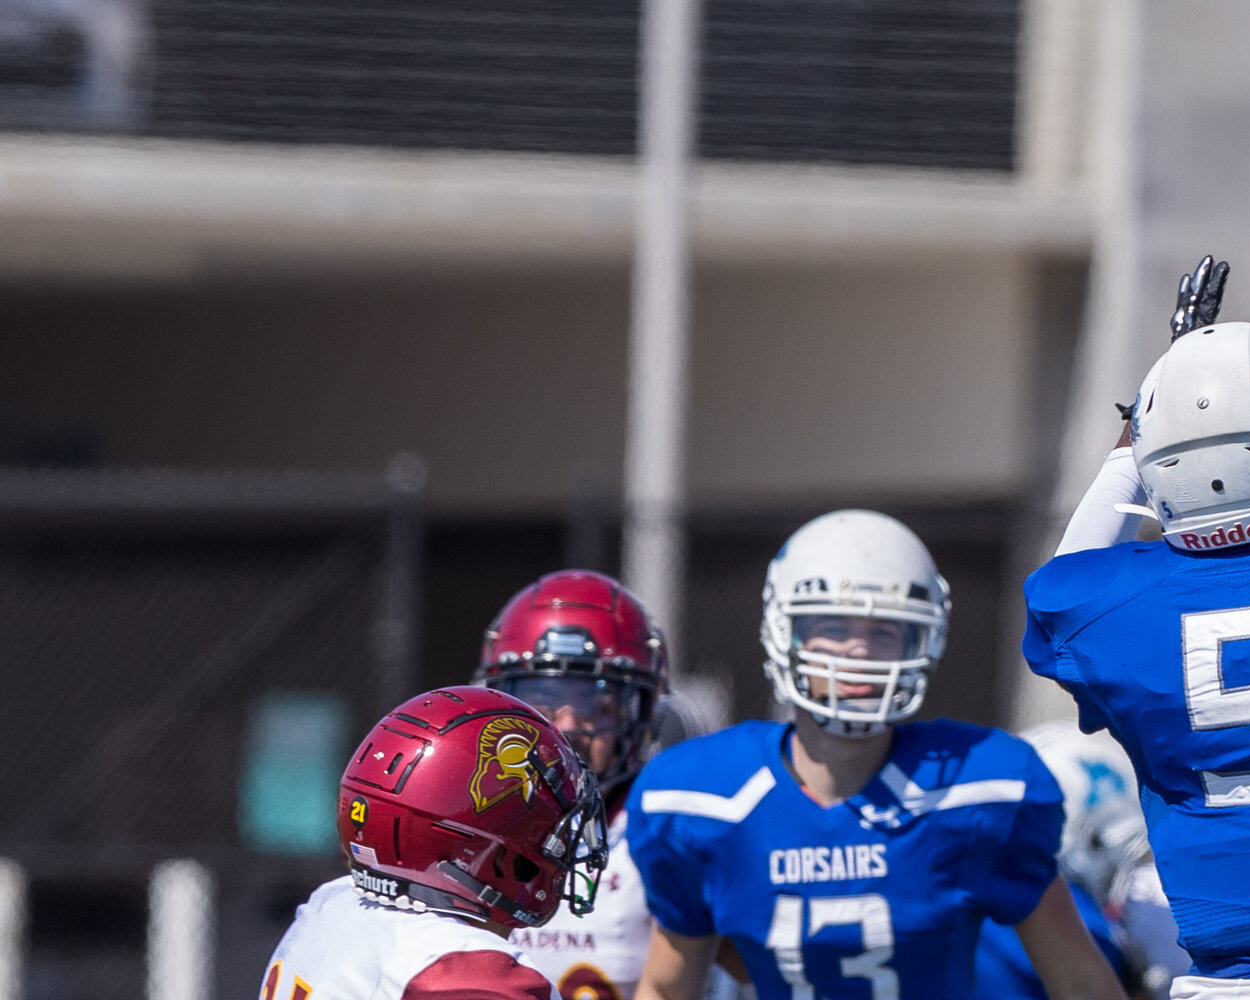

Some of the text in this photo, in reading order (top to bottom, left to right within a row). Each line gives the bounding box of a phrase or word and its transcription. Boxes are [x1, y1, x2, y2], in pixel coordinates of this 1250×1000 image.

[1160, 501, 1174, 519] 5
[349, 801, 366, 823] 21
[769, 844, 888, 884] CORSAIRS
[351, 868, 399, 897] schutt
